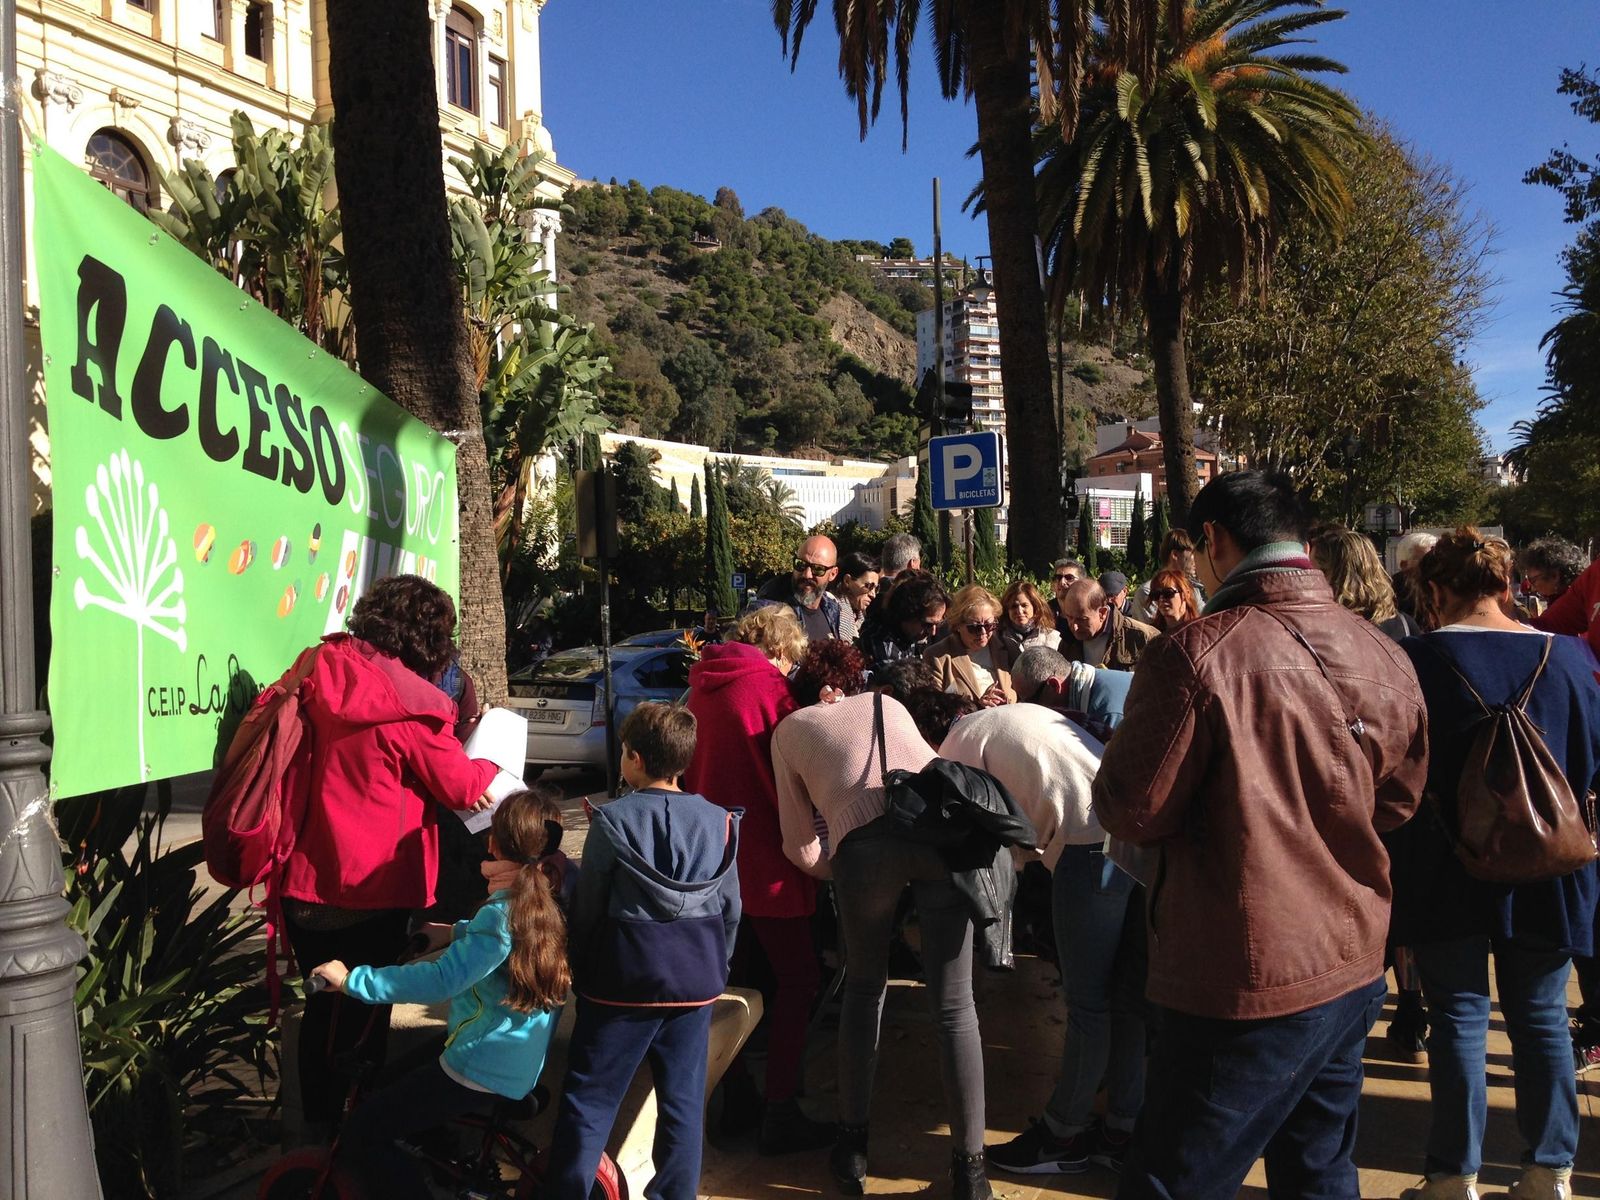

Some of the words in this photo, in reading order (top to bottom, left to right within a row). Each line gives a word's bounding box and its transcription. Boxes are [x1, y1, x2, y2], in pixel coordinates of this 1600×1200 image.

[71, 254, 346, 506] ACCESO
[338, 421, 445, 545] SEGURO
[943, 443, 983, 500] P
[959, 488, 996, 499] BICICLETAS
[733, 575, 743, 587] P
[188, 653, 227, 716] La
